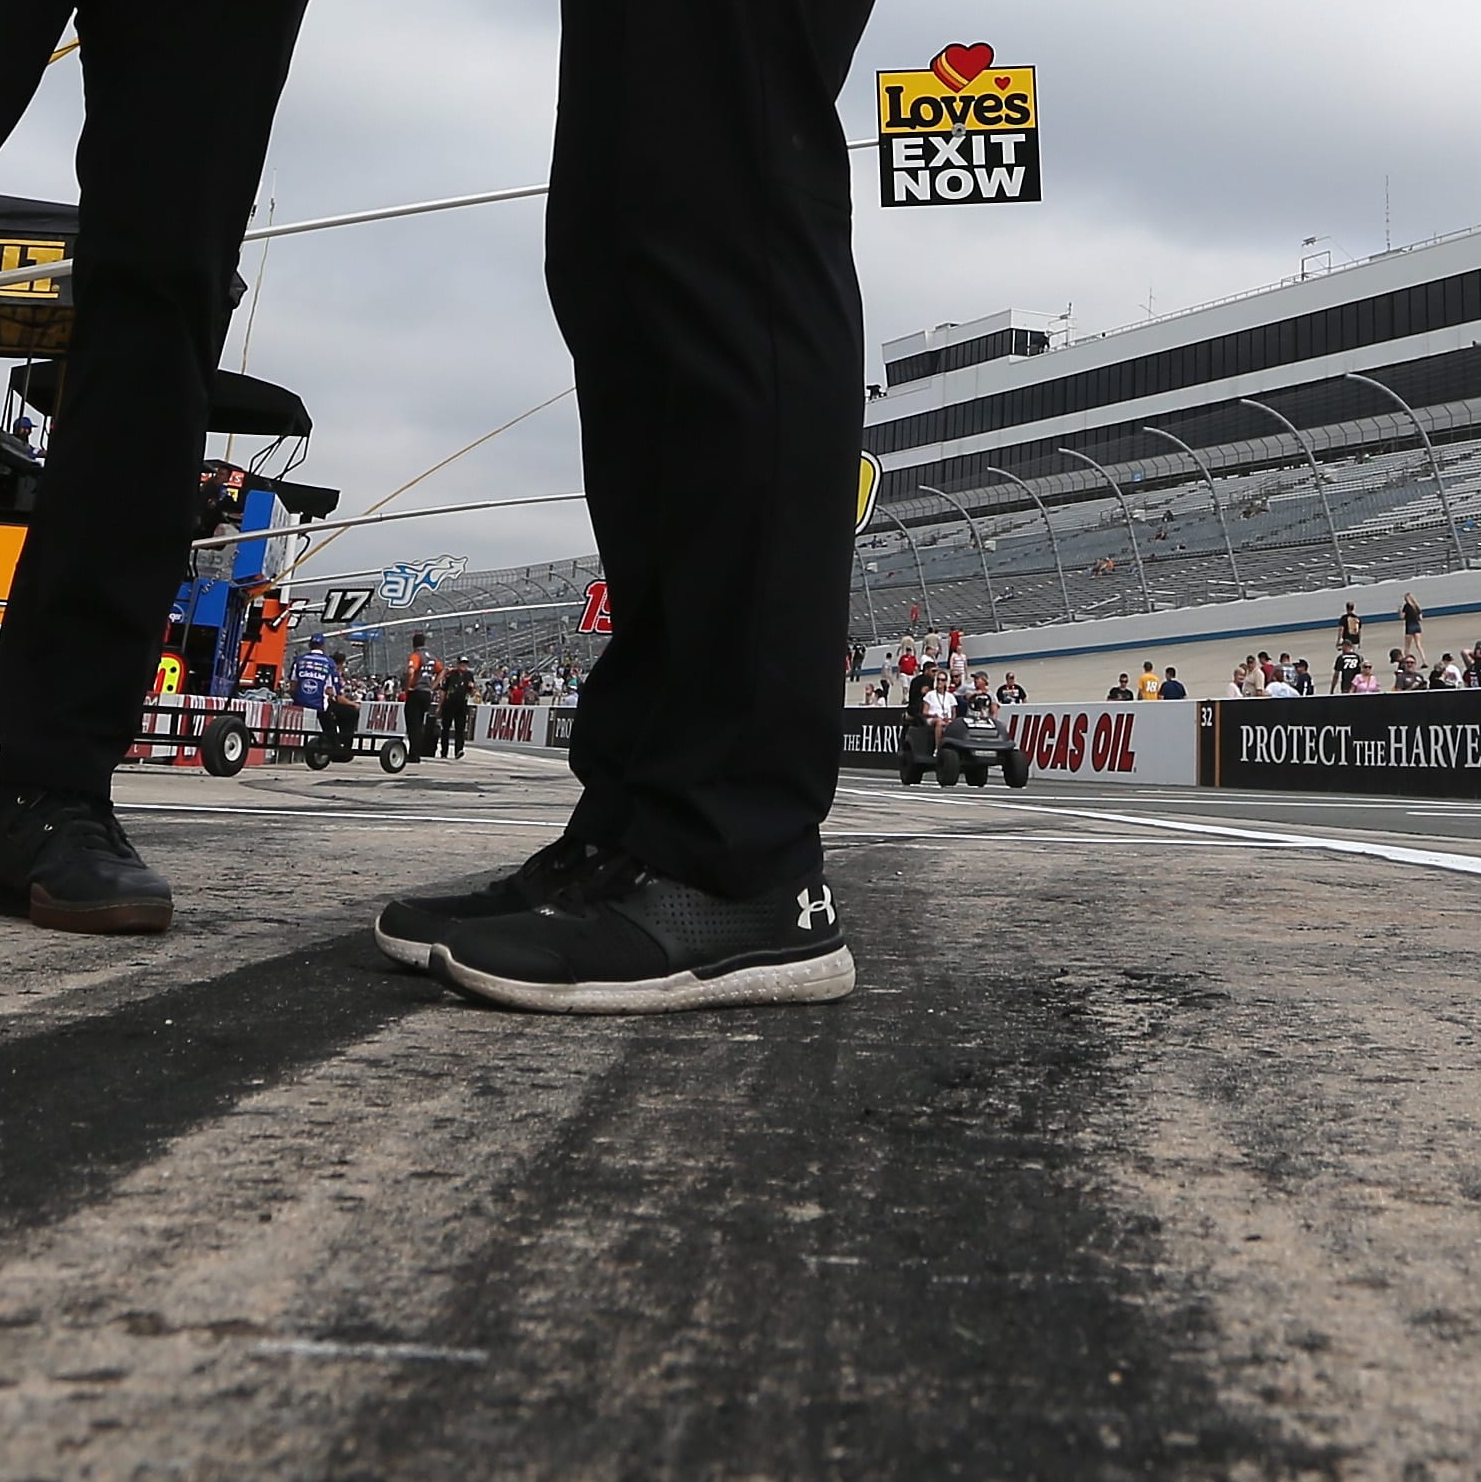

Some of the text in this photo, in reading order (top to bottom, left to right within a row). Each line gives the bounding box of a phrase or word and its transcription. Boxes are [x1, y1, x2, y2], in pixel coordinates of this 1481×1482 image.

[892, 134, 1026, 169] EXIT
[893, 166, 1026, 202] NOW
[324, 591, 372, 620] 17
[1341, 658, 1359, 669] 78
[1145, 680, 1158, 693] 18
[487, 708, 534, 741] LUCAS OIL
[1201, 706, 1213, 727] 32
[843, 733, 861, 752] THE
[1008, 713, 1136, 773] LUCAS OIL
[1239, 724, 1352, 767] PROTECT
[1352, 740, 1387, 767] THE
